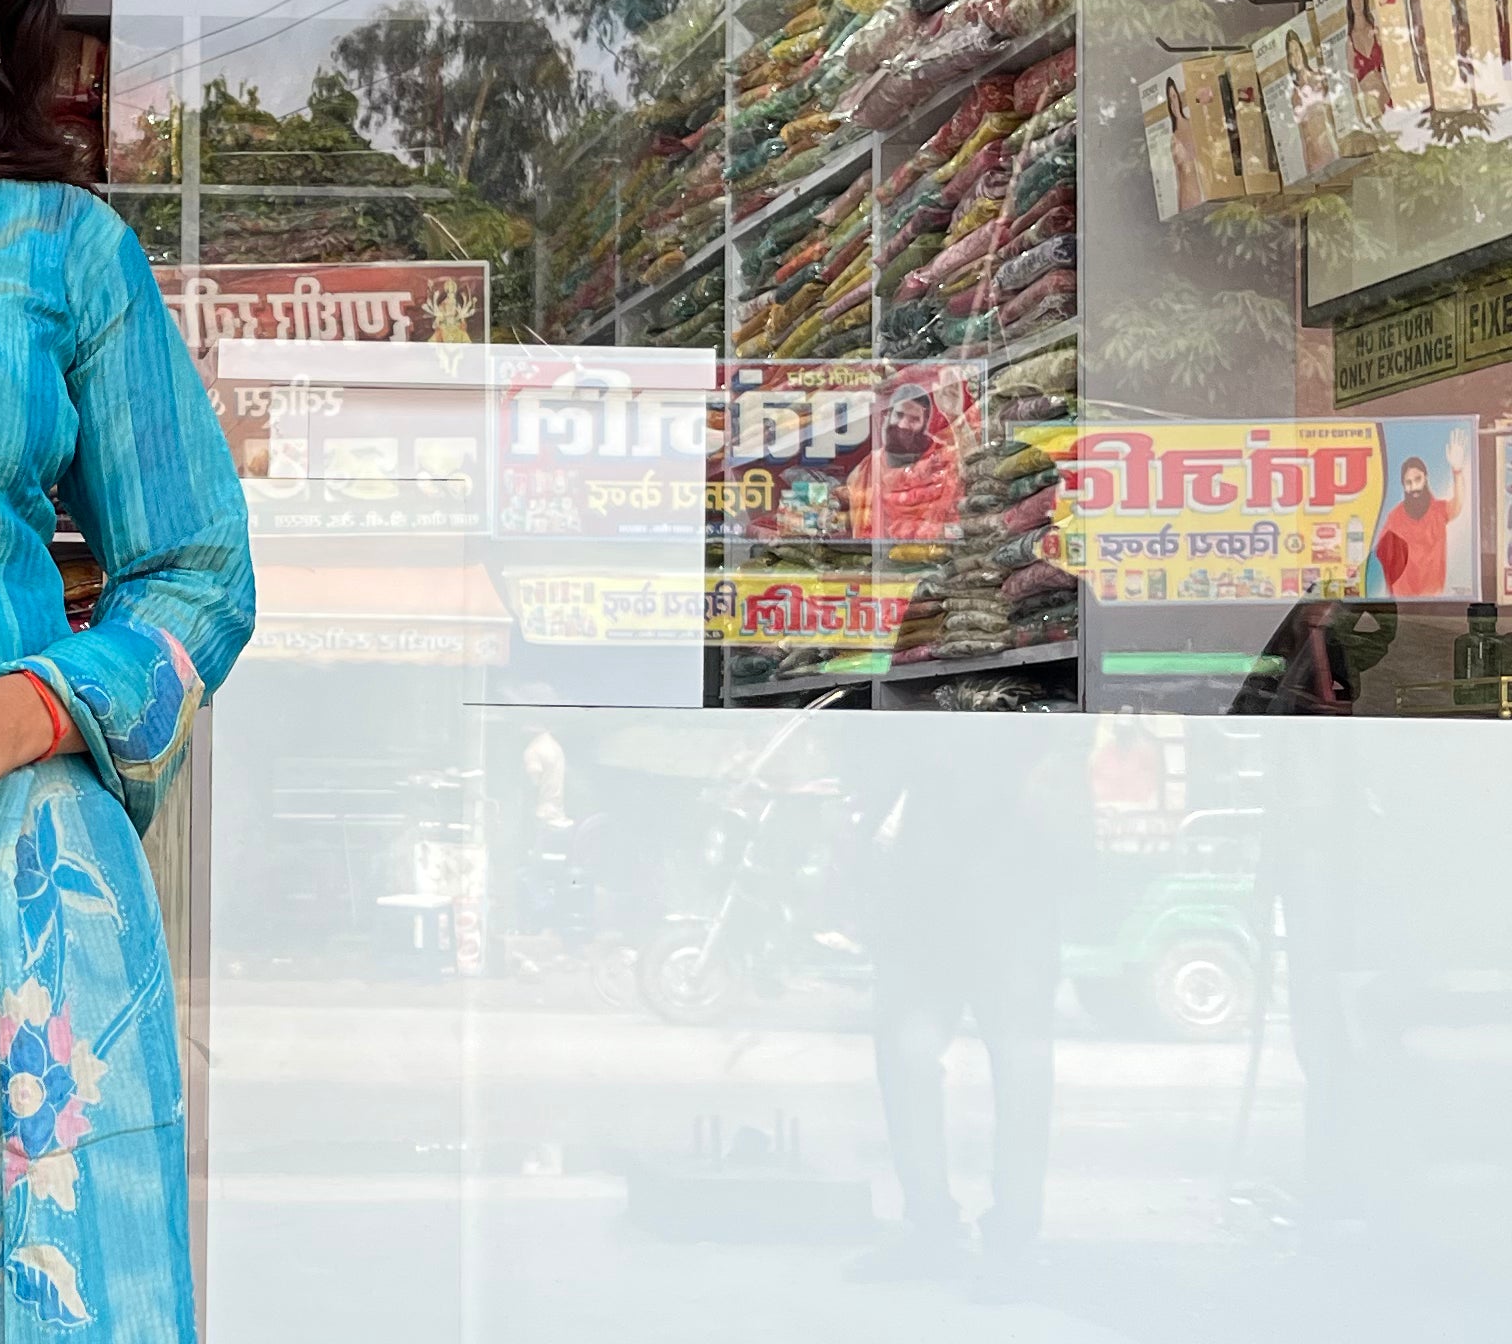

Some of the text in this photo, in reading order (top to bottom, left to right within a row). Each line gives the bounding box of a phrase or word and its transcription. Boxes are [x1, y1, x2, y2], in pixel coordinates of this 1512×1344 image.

[1355, 310, 1434, 357] NO RETURN
[1339, 334, 1453, 391] ONLY EXCHANGE
